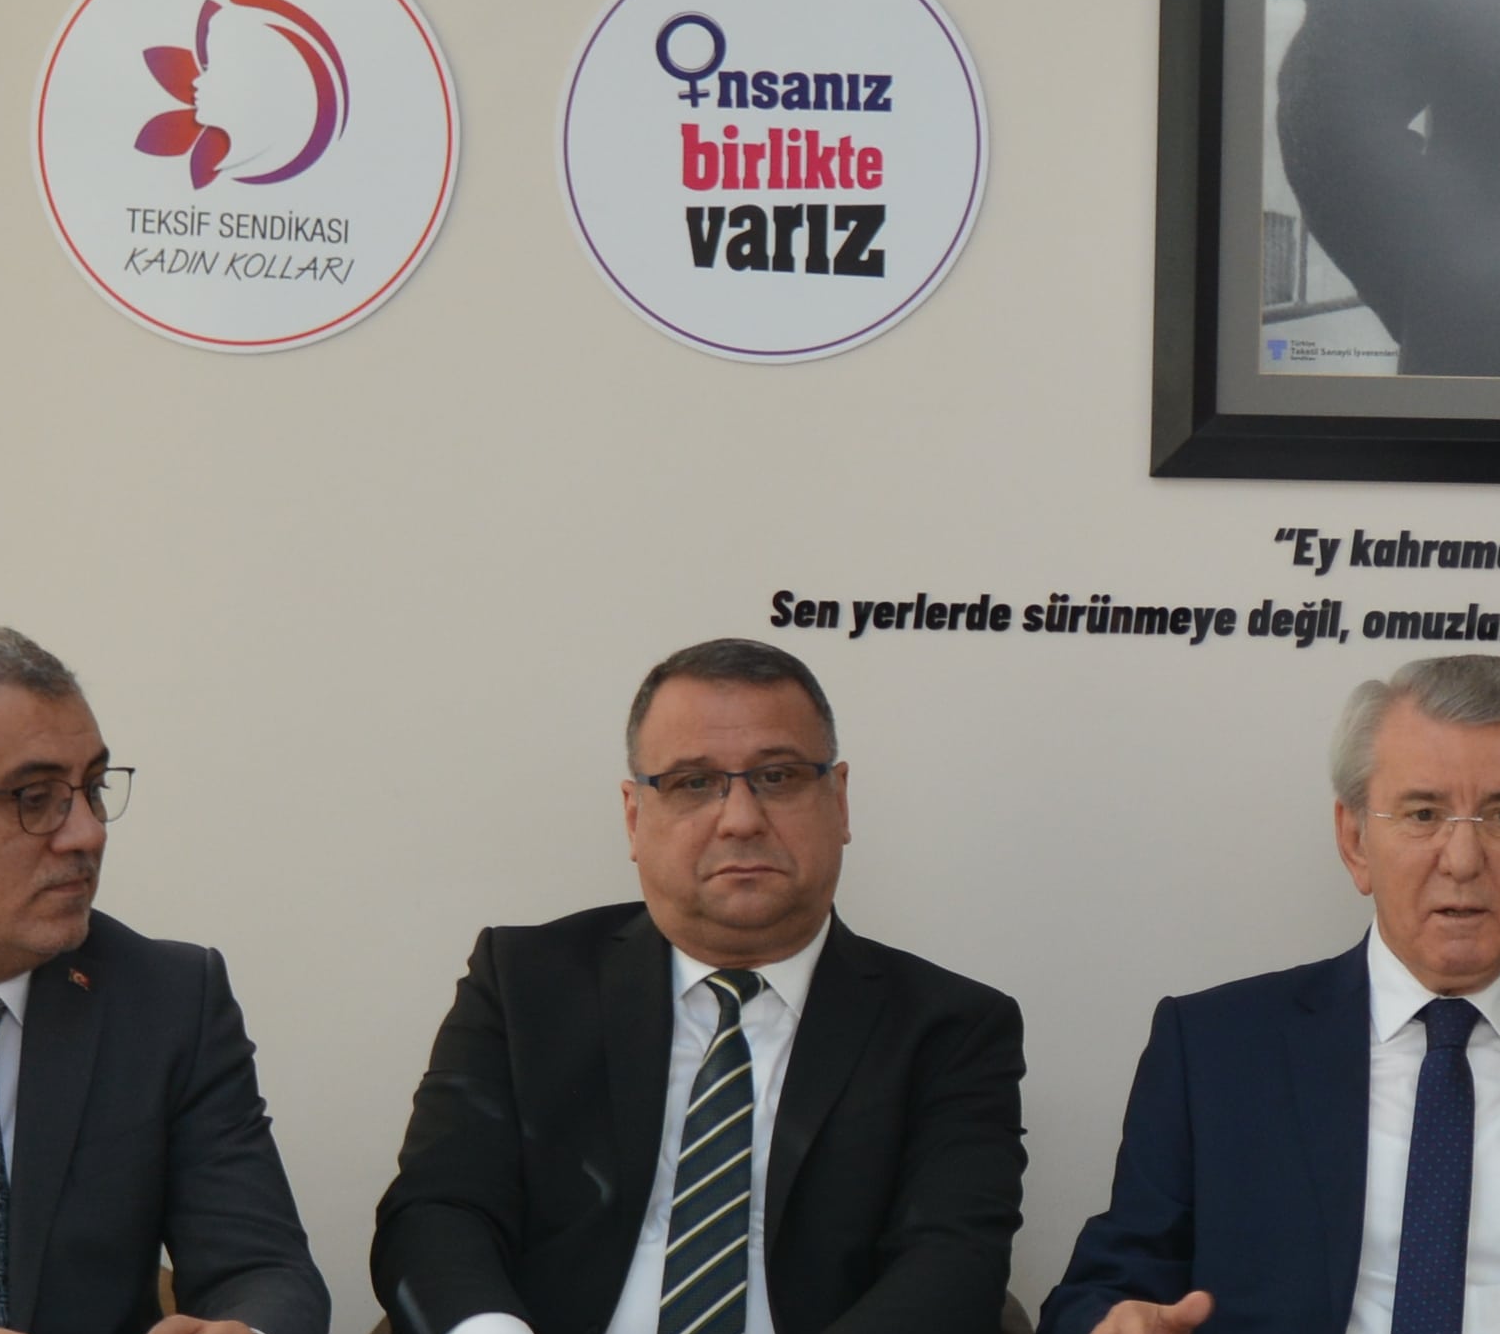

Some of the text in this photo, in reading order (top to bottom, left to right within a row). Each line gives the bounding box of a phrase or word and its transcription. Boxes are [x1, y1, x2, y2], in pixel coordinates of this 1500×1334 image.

[681, 123, 884, 192] birlikte
[126, 205, 350, 244] TEKSİF SENDİKASI
[685, 202, 887, 279] varız
[124, 247, 355, 285] KADIN KOLLARI
[769, 589, 840, 630] Sen
[848, 592, 1012, 640] yerlerde
[1021, 592, 1237, 646] sürünmeye
[1247, 598, 1350, 649] değil,
